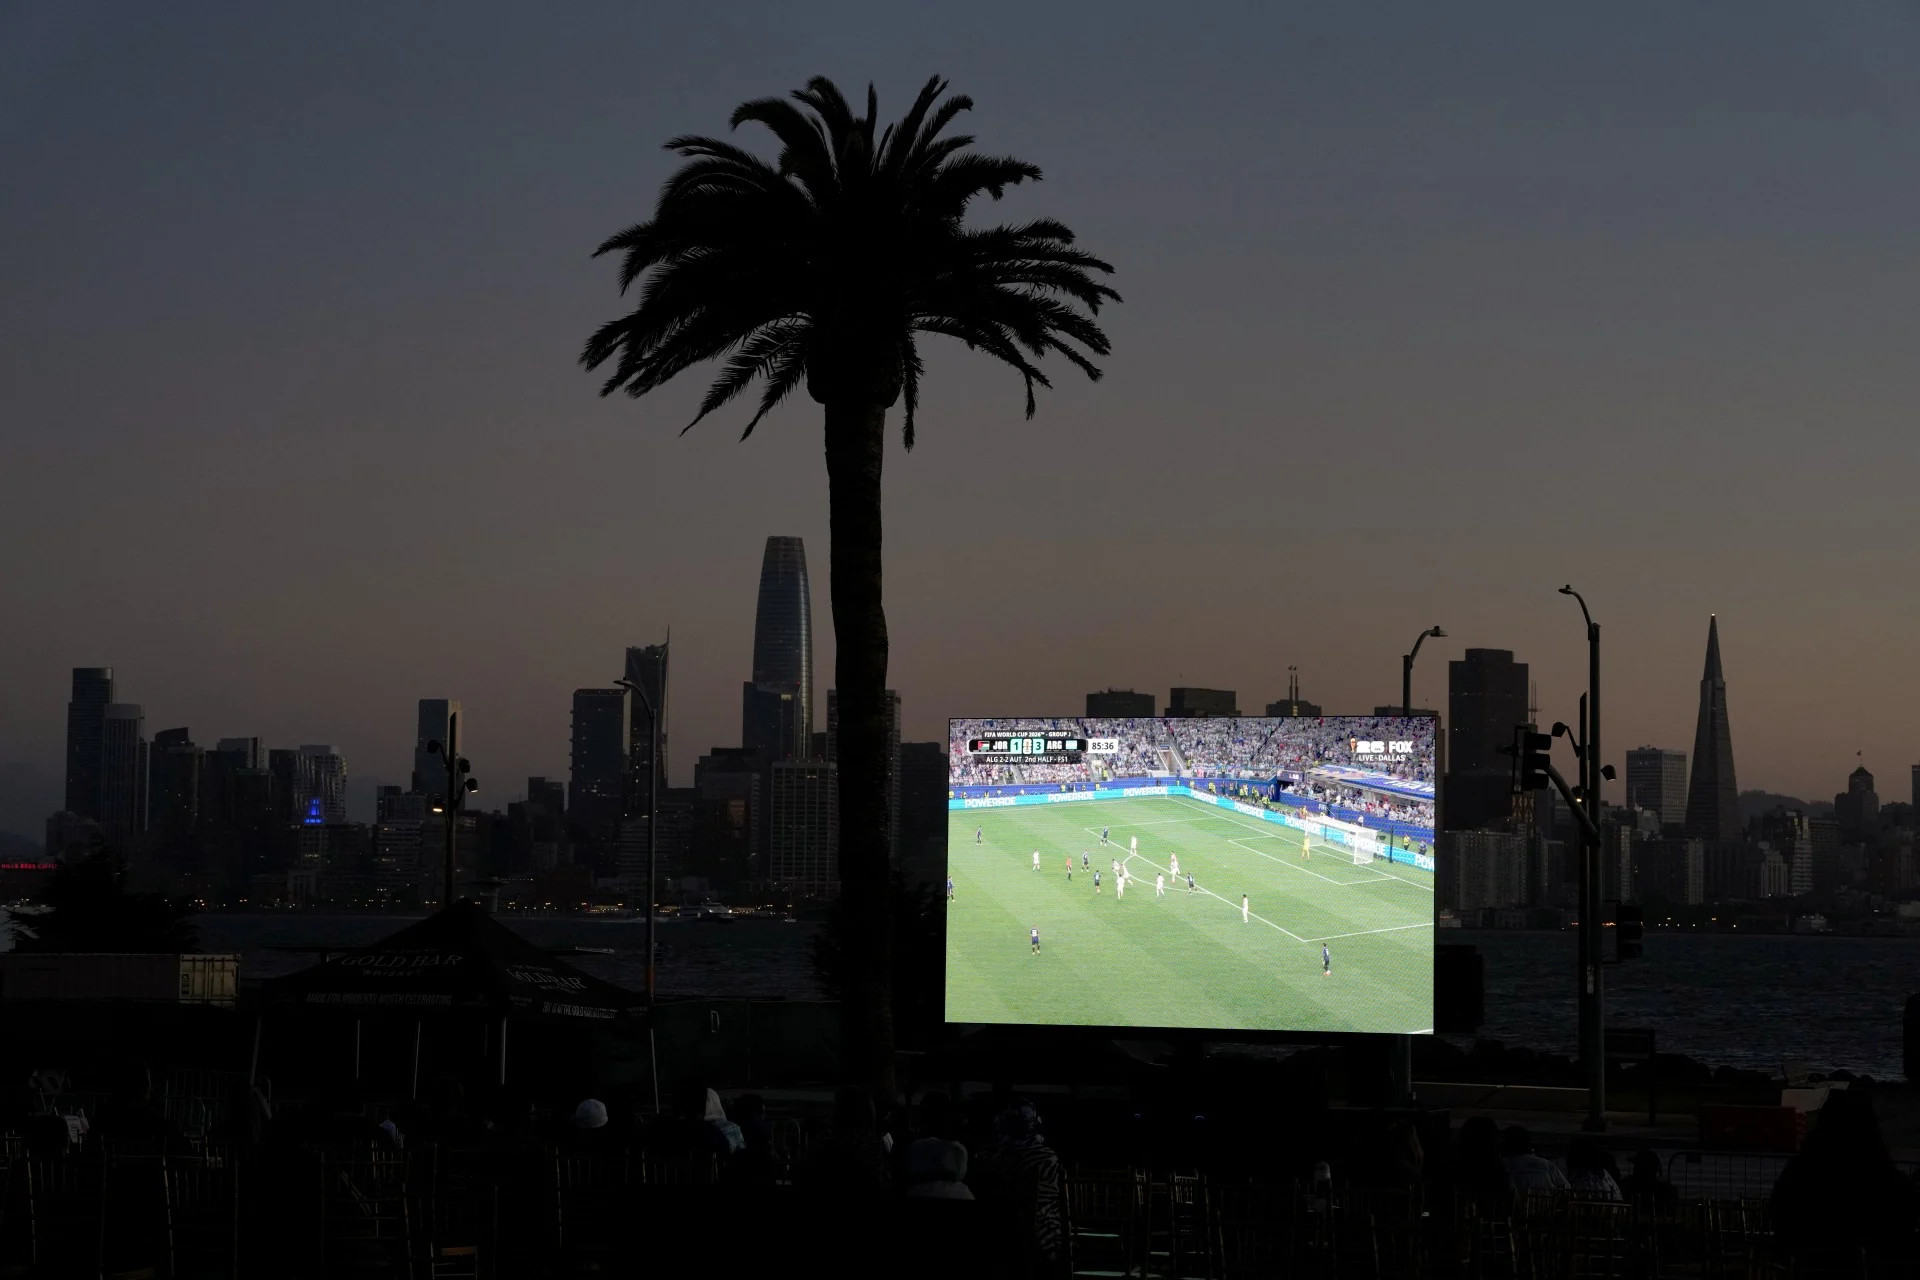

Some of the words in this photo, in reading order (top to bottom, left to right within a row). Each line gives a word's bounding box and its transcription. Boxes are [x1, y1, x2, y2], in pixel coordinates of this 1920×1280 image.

[993, 741, 1008, 750] JOR
[1013, 742, 1019, 751] 1
[1035, 742, 1041, 751] 3
[1046, 741, 1063, 750] ARG
[1091, 742, 1114, 750] 85:36
[1388, 741, 1414, 754] FOX
[1358, 754, 1374, 762] LIVE
[1378, 754, 1406, 762] DALLAS
[1047, 790, 1095, 803] POWERADE
[1123, 786, 1167, 798] POWERADE
[964, 796, 1016, 808] POWERADE
[341, 955, 407, 968] GOLD
[409, 954, 463, 968] BAR
[306, 992, 328, 1004] MADE
[341, 993, 377, 1005] MOMENTS
[405, 993, 453, 1006] CELEBRATING
